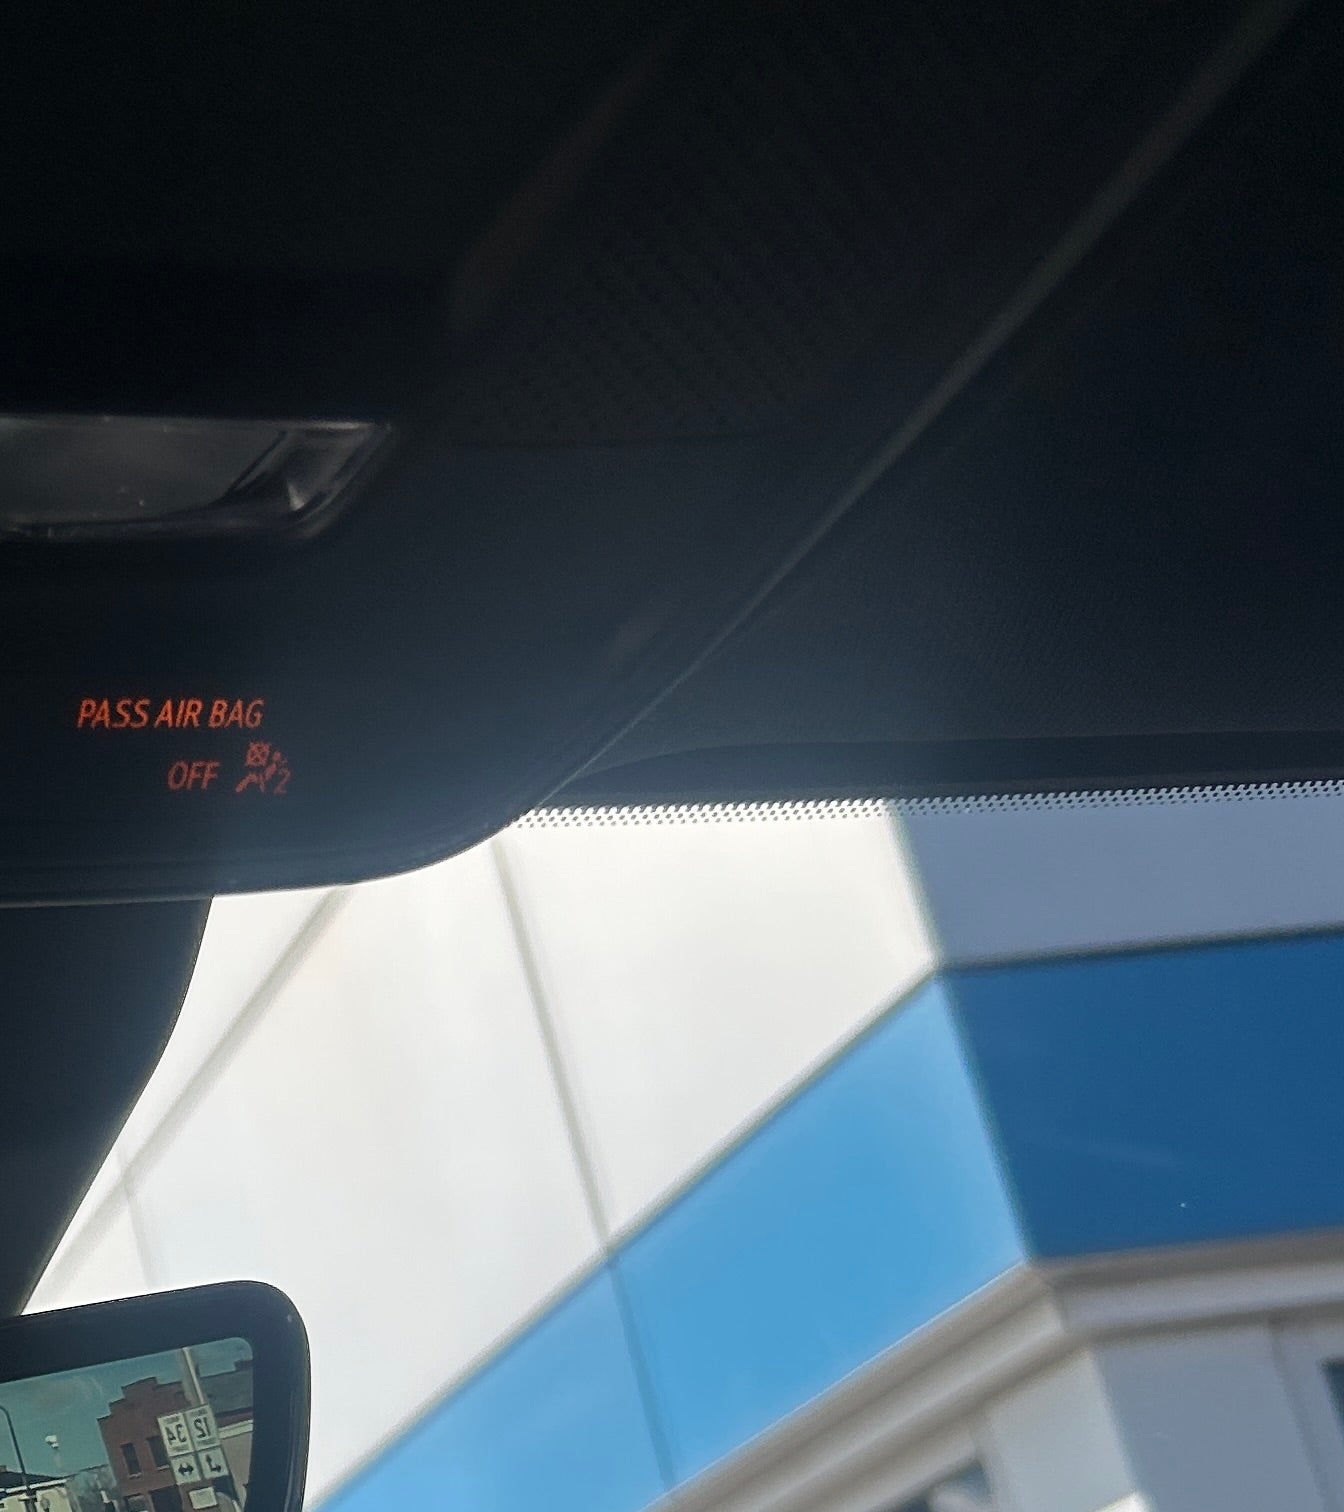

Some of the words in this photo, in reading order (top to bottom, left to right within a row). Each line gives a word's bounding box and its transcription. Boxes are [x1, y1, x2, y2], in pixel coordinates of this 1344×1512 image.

[77, 698, 150, 728] PASS
[153, 698, 203, 728] AIR
[208, 699, 264, 728] BAG
[167, 760, 220, 790] OFF
